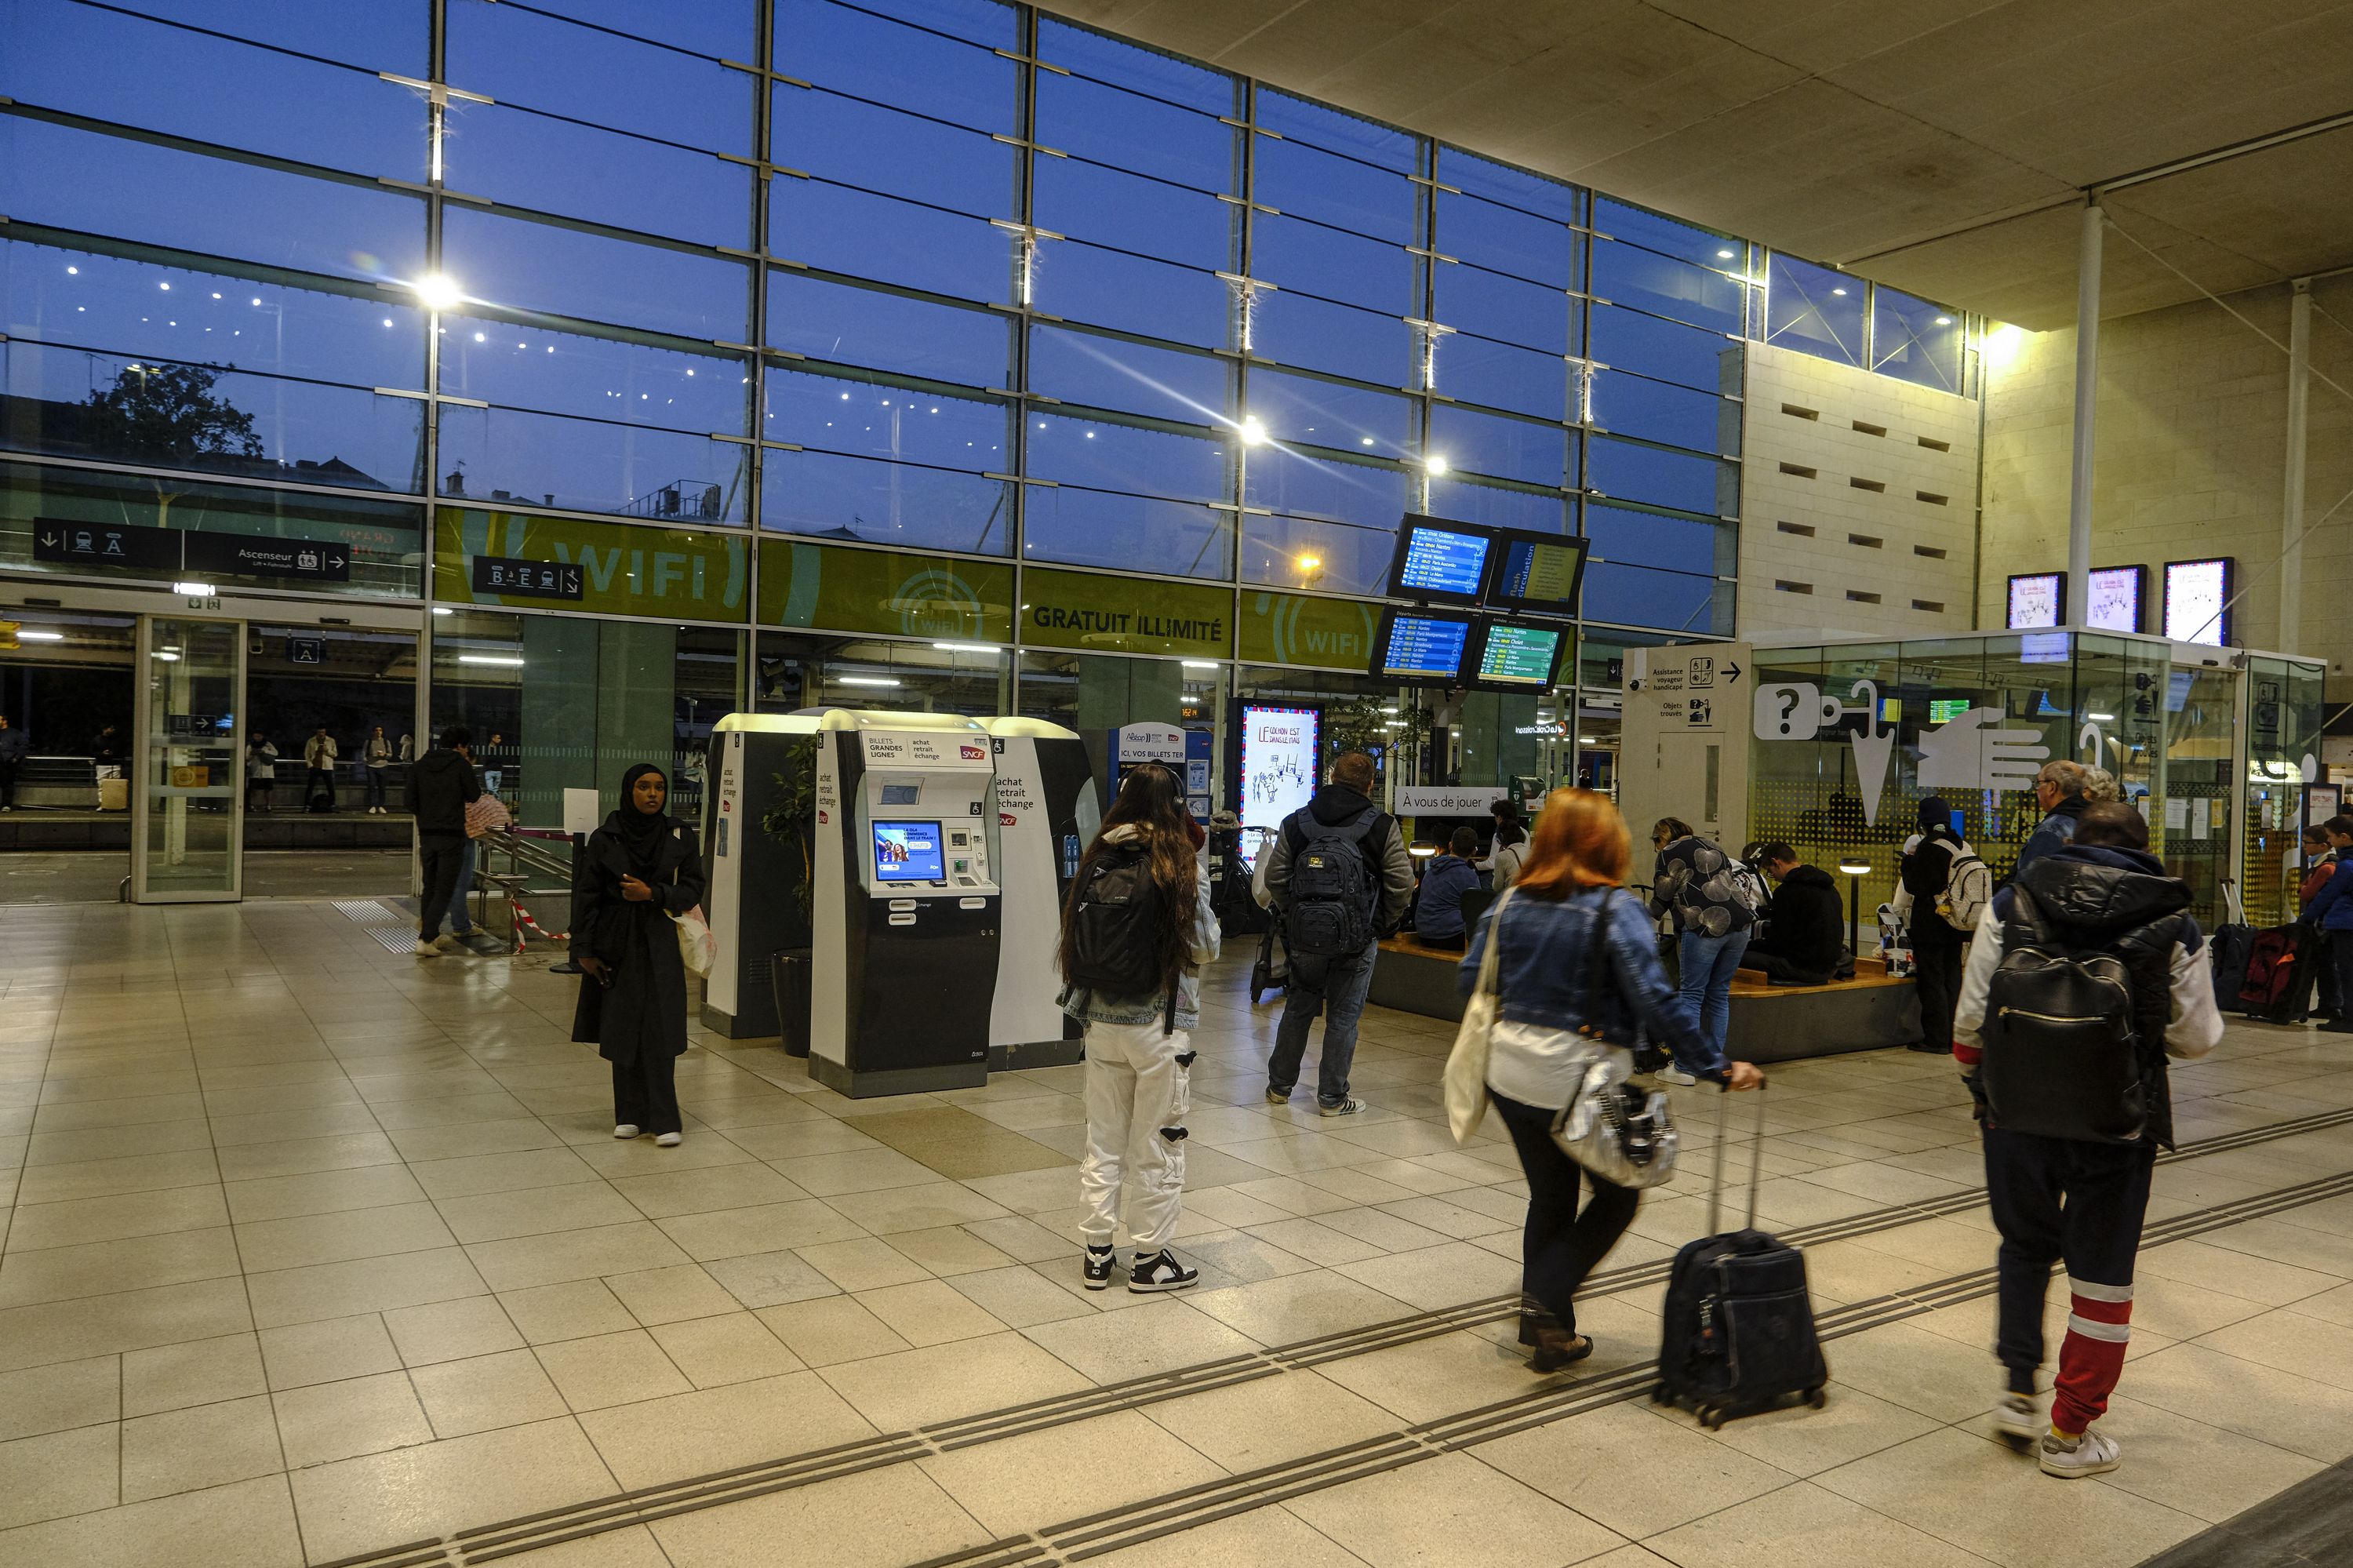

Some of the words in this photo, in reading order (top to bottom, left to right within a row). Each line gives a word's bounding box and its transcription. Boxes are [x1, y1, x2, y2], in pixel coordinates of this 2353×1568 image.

[107, 540, 121, 552] A
[238, 548, 293, 561] Ascenseur
[554, 542, 704, 599] WIFI
[1518, 545, 1535, 598] circulation
[493, 571, 503, 584] B
[521, 573, 529, 585] E
[1510, 573, 1521, 596] flash
[1034, 606, 1130, 634] GRATUIT
[1137, 616, 1222, 642] ILLIMITÉ
[1304, 629, 1359, 656] WIFI
[1447, 625, 1464, 671] départs
[300, 649, 312, 660] A
[1259, 726, 1269, 743] LE
[1269, 726, 1288, 735] COCHON
[1289, 727, 1300, 736] EST
[819, 773, 831, 782] achat
[997, 777, 1022, 786] achat
[819, 784, 833, 794] retrait
[997, 788, 1026, 797] retrait
[819, 796, 836, 808] échange
[998, 799, 1034, 810] échange
[1402, 792, 1412, 807] À
[1414, 799, 1438, 807] vous
[1441, 795, 1454, 807] de
[1456, 795, 1482, 810] jouer
